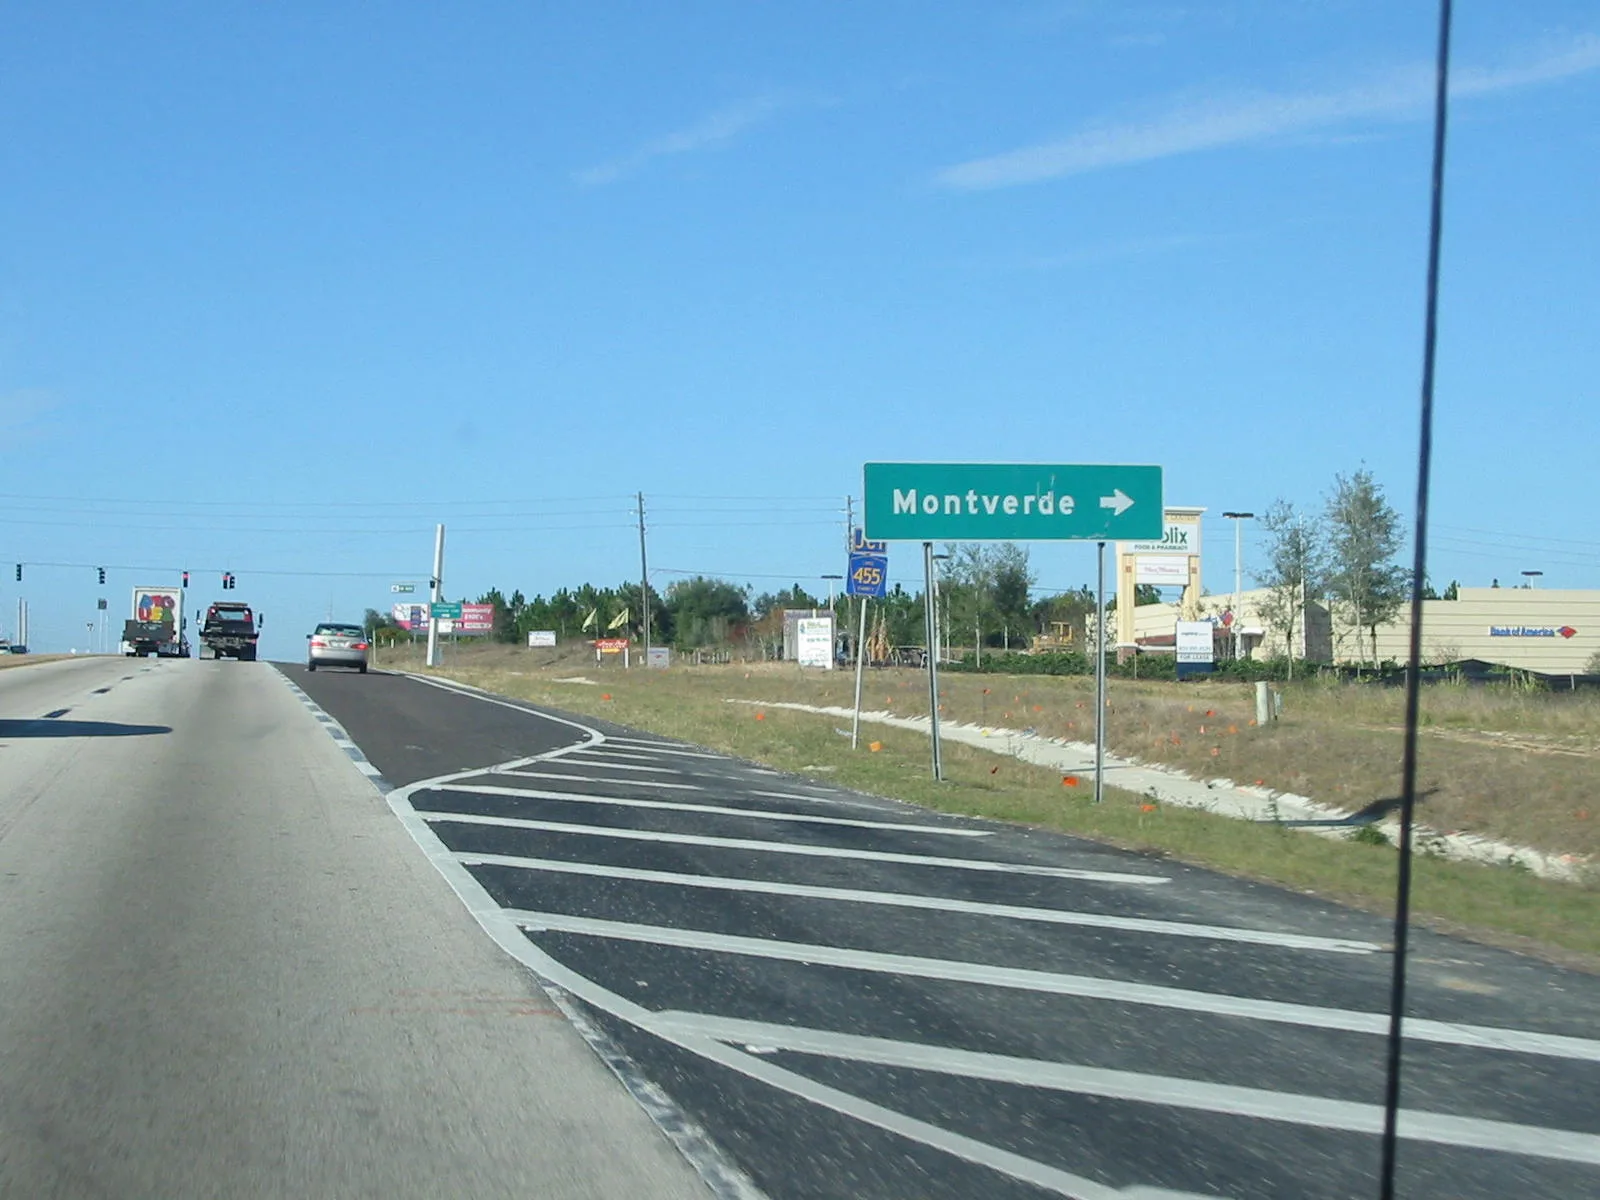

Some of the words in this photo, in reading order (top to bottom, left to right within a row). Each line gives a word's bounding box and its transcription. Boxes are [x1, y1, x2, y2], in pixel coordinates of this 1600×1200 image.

[893, 488, 1075, 515] Montverde
[853, 567, 881, 585] 455
[1490, 625, 1510, 637] Bank
[1511, 625, 1520, 637] of
[1521, 625, 1555, 637] America
